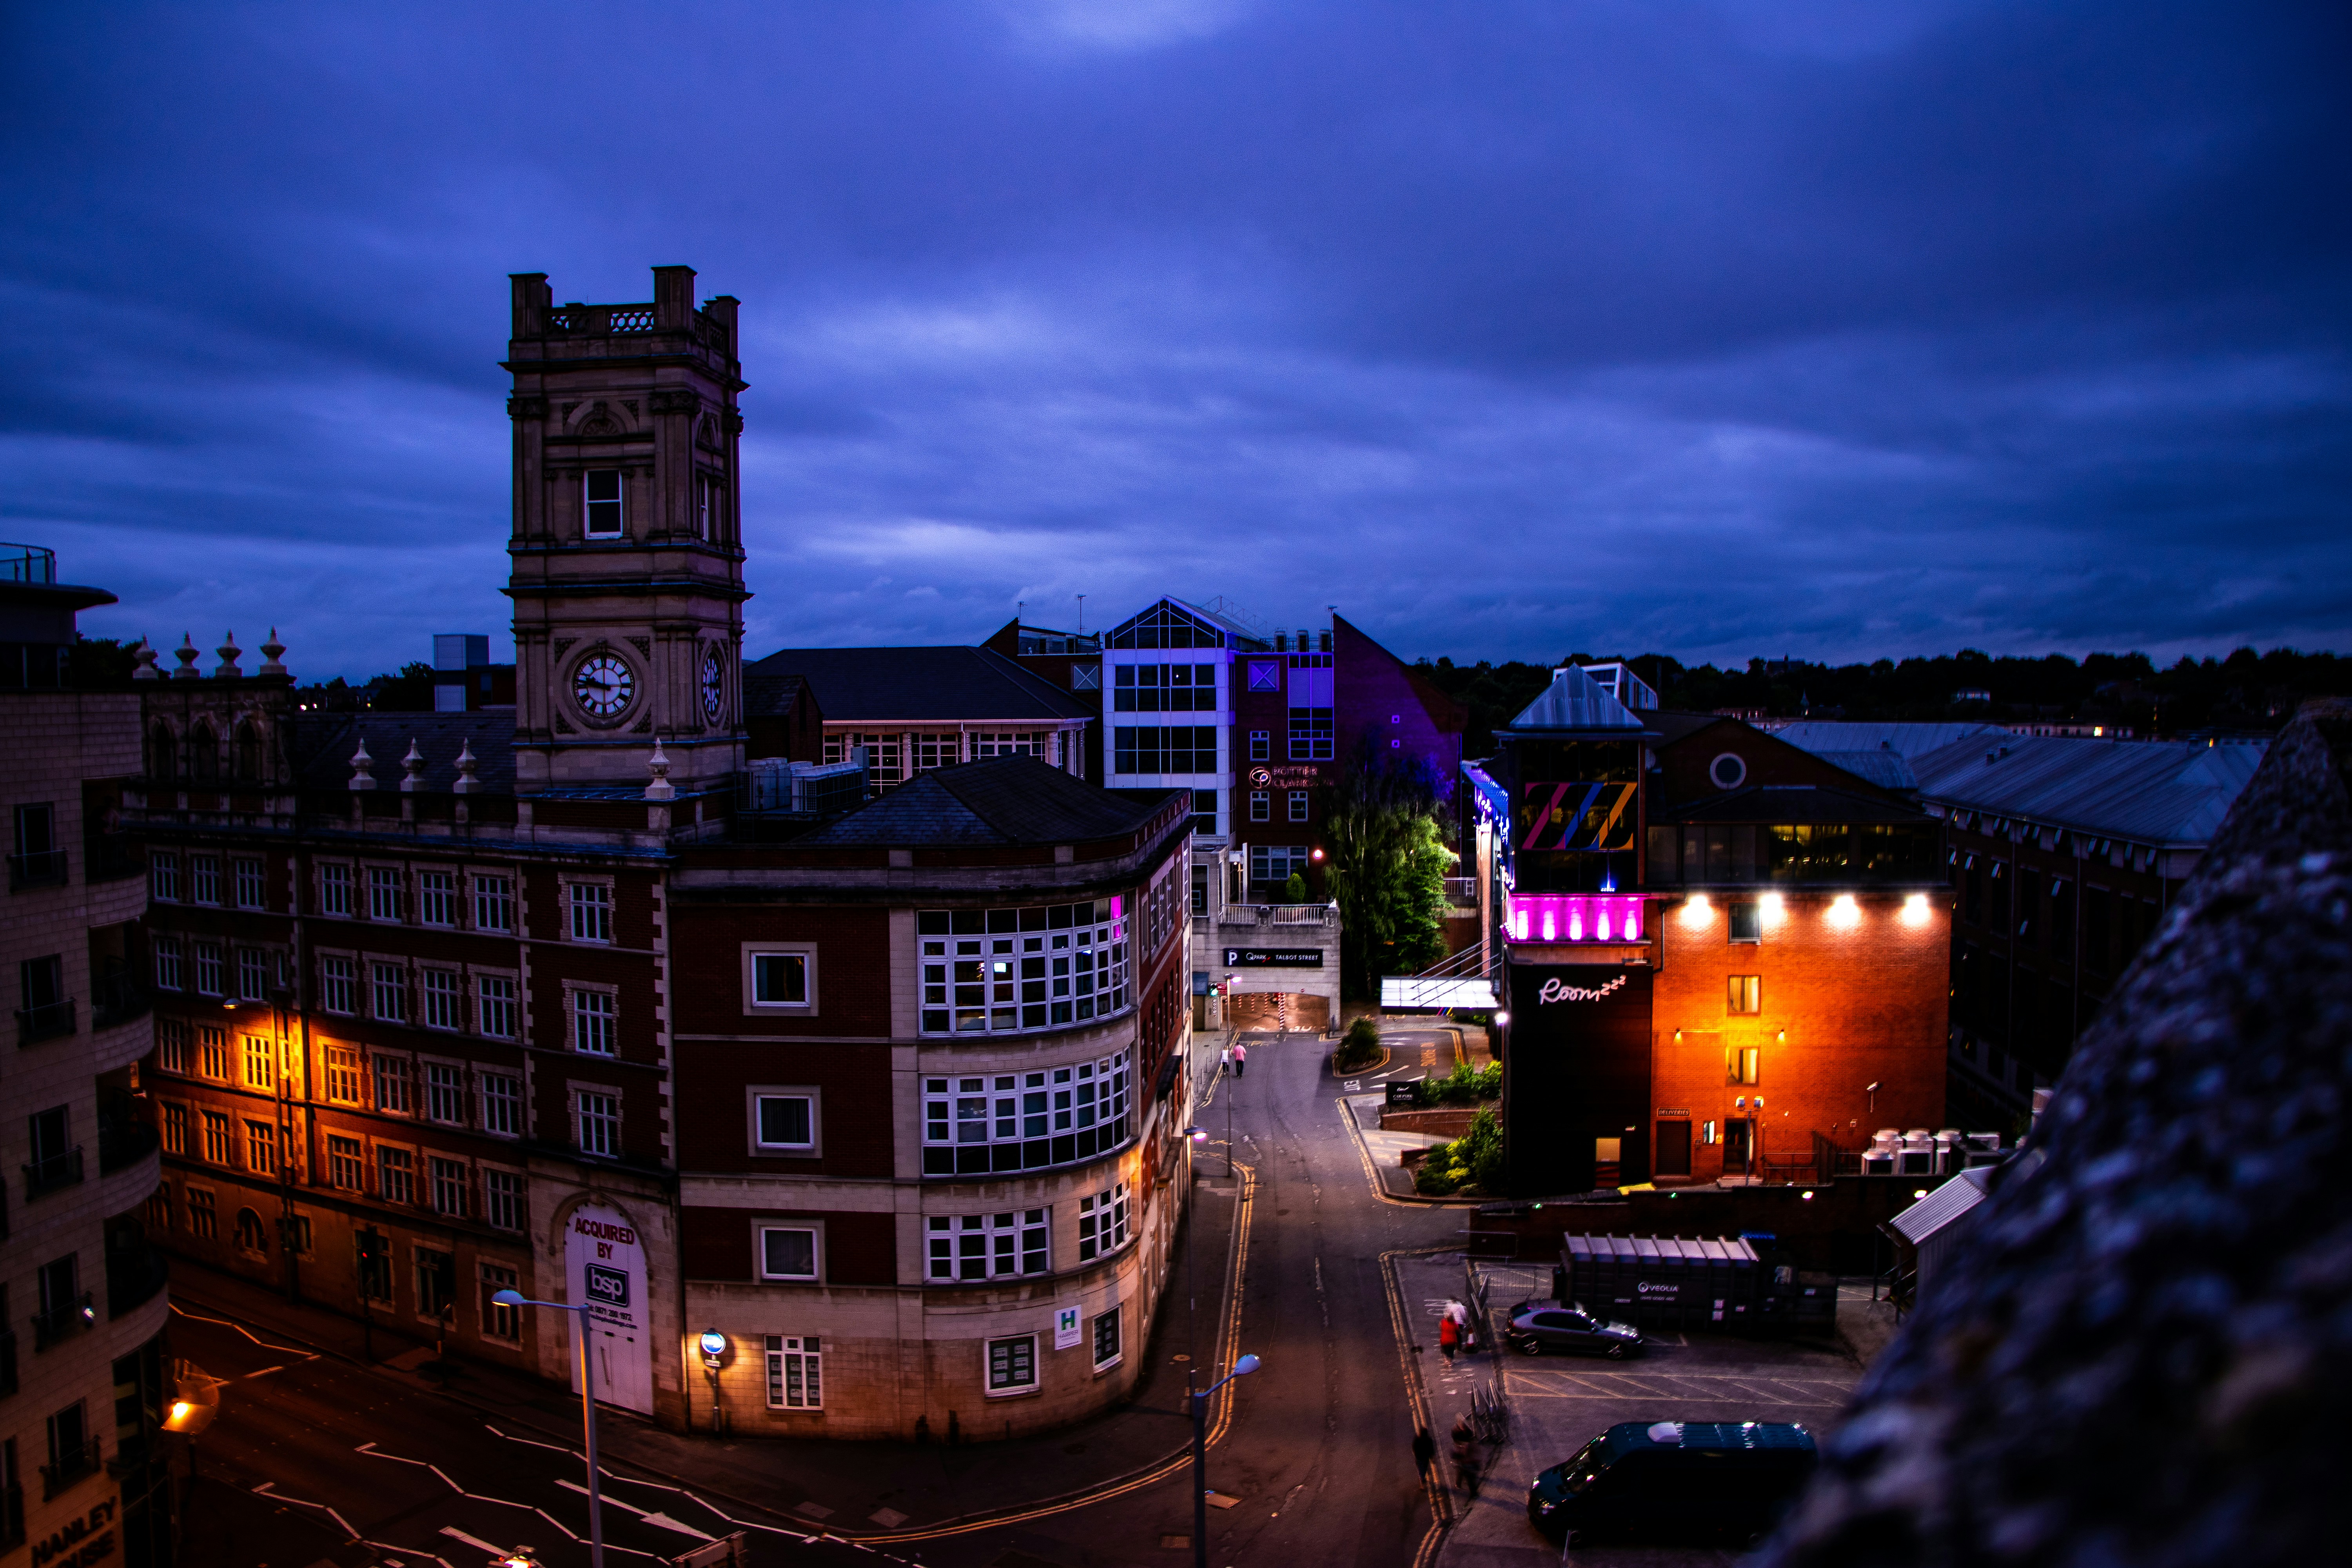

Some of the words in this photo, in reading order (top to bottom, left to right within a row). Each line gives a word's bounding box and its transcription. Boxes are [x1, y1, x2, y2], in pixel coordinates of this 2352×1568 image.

[1272, 766, 1318, 777] POTTER
[1272, 777, 1334, 789] CLARKSN
[575, 1217, 635, 1245] ACQUIRED
[597, 1241, 613, 1260] BY
[590, 1268, 623, 1301] bsp
[1649, 1283, 1679, 1292] VEOLIA
[31, 1495, 116, 1568] HANLEY
